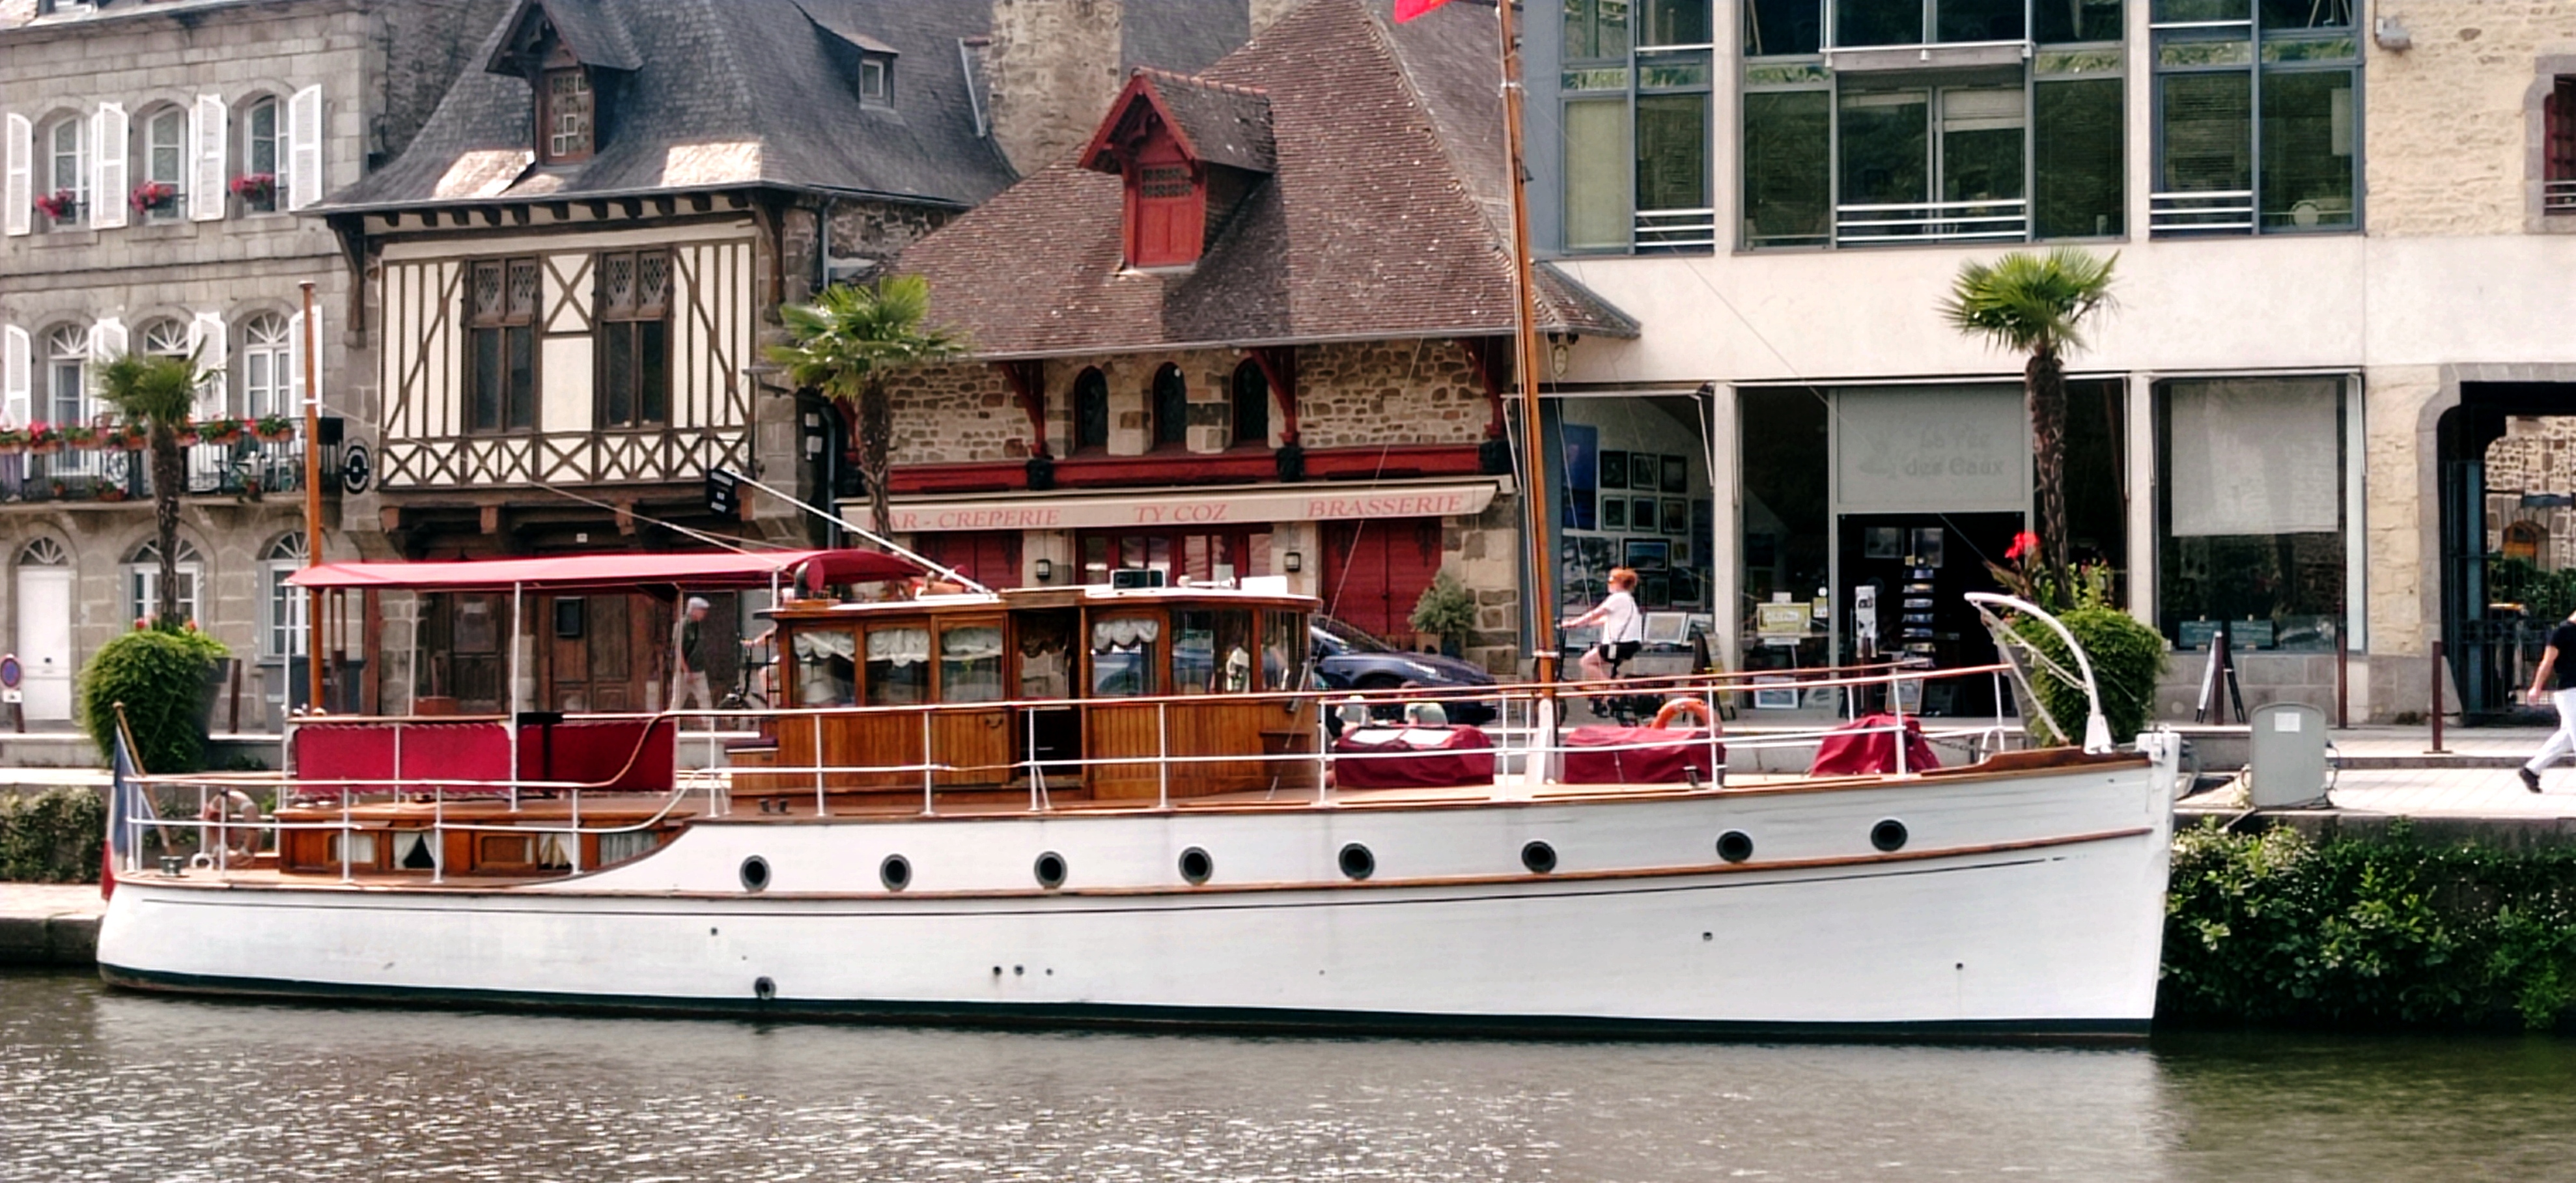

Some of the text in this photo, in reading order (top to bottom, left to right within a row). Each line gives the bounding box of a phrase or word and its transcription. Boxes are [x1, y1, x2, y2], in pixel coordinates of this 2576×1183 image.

[1134, 503, 1227, 522] TY COZ
[1308, 494, 1463, 518] BRASSERIE
[937, 508, 1061, 529] CREPERIE
